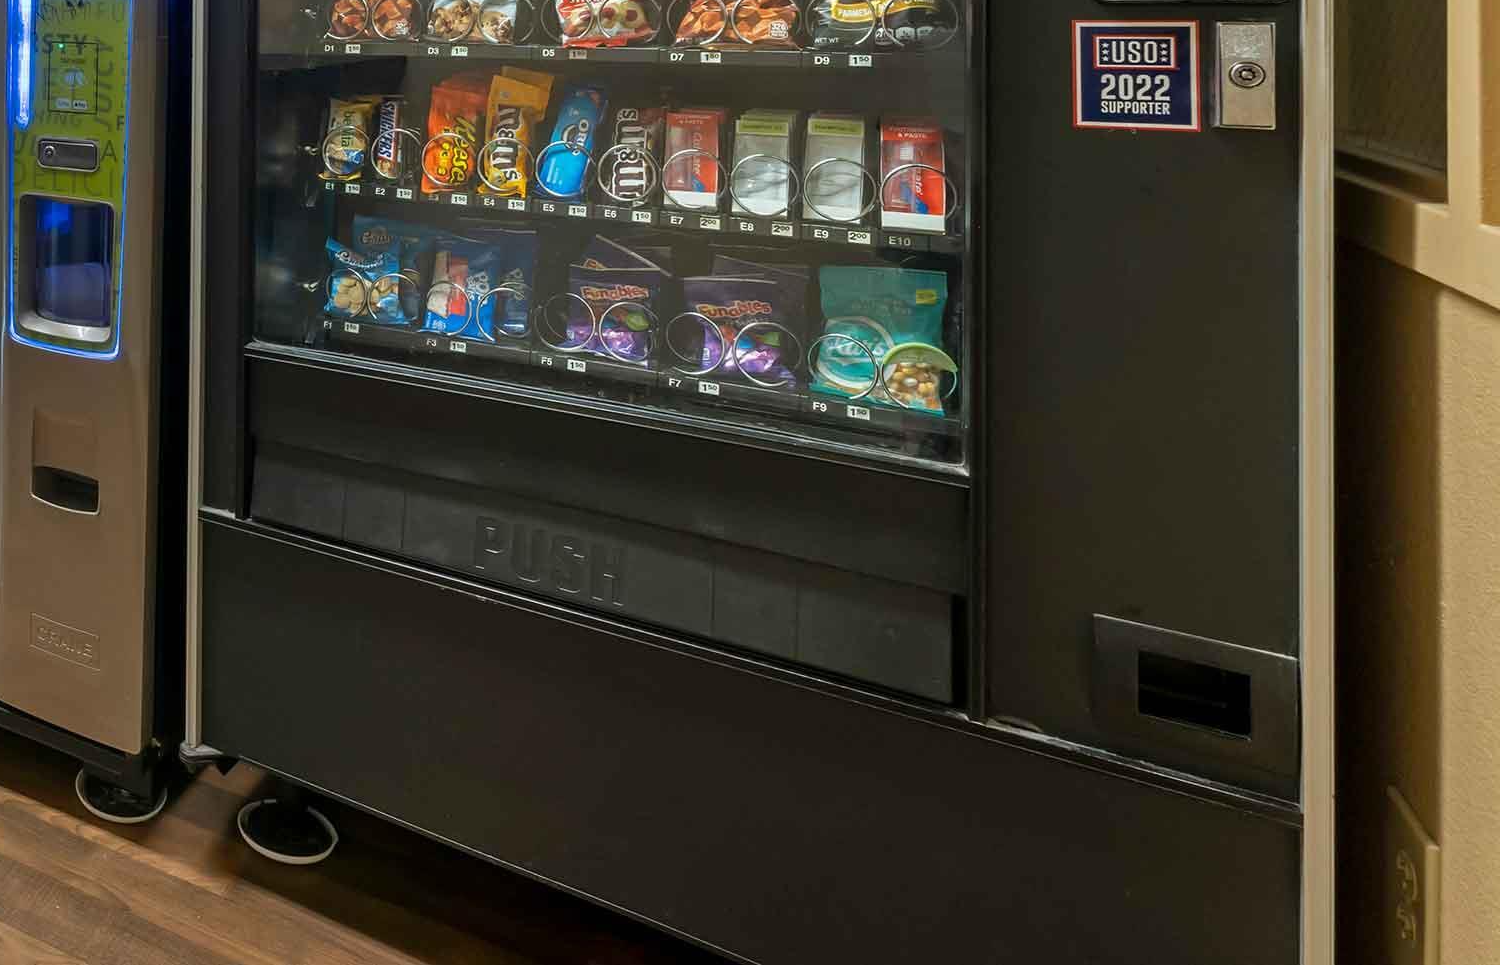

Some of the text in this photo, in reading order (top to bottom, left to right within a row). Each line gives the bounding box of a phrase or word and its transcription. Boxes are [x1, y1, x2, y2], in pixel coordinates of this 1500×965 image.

[428, 47, 439, 55] D3
[542, 49, 555, 57] D5
[1111, 40, 1158, 64] USO
[670, 53, 684, 61] D7
[814, 56, 830, 65] D9
[1100, 73, 1171, 102] 2022
[1100, 100, 1171, 115] SUPPORTER
[378, 101, 396, 159] SNICKERS
[375, 188, 385, 196] E2
[484, 198, 495, 206] E4
[542, 203, 555, 212] E5
[604, 209, 617, 218] E6
[670, 216, 684, 225] E7
[739, 222, 754, 231] E8
[814, 229, 829, 239] E9
[888, 236, 911, 246] E10
[697, 300, 772, 318] Funables
[323, 321, 332, 329] F1
[541, 357, 552, 366] F5
[669, 378, 682, 387] F7
[812, 401, 828, 412] F9
[474, 514, 625, 608] PUSH
